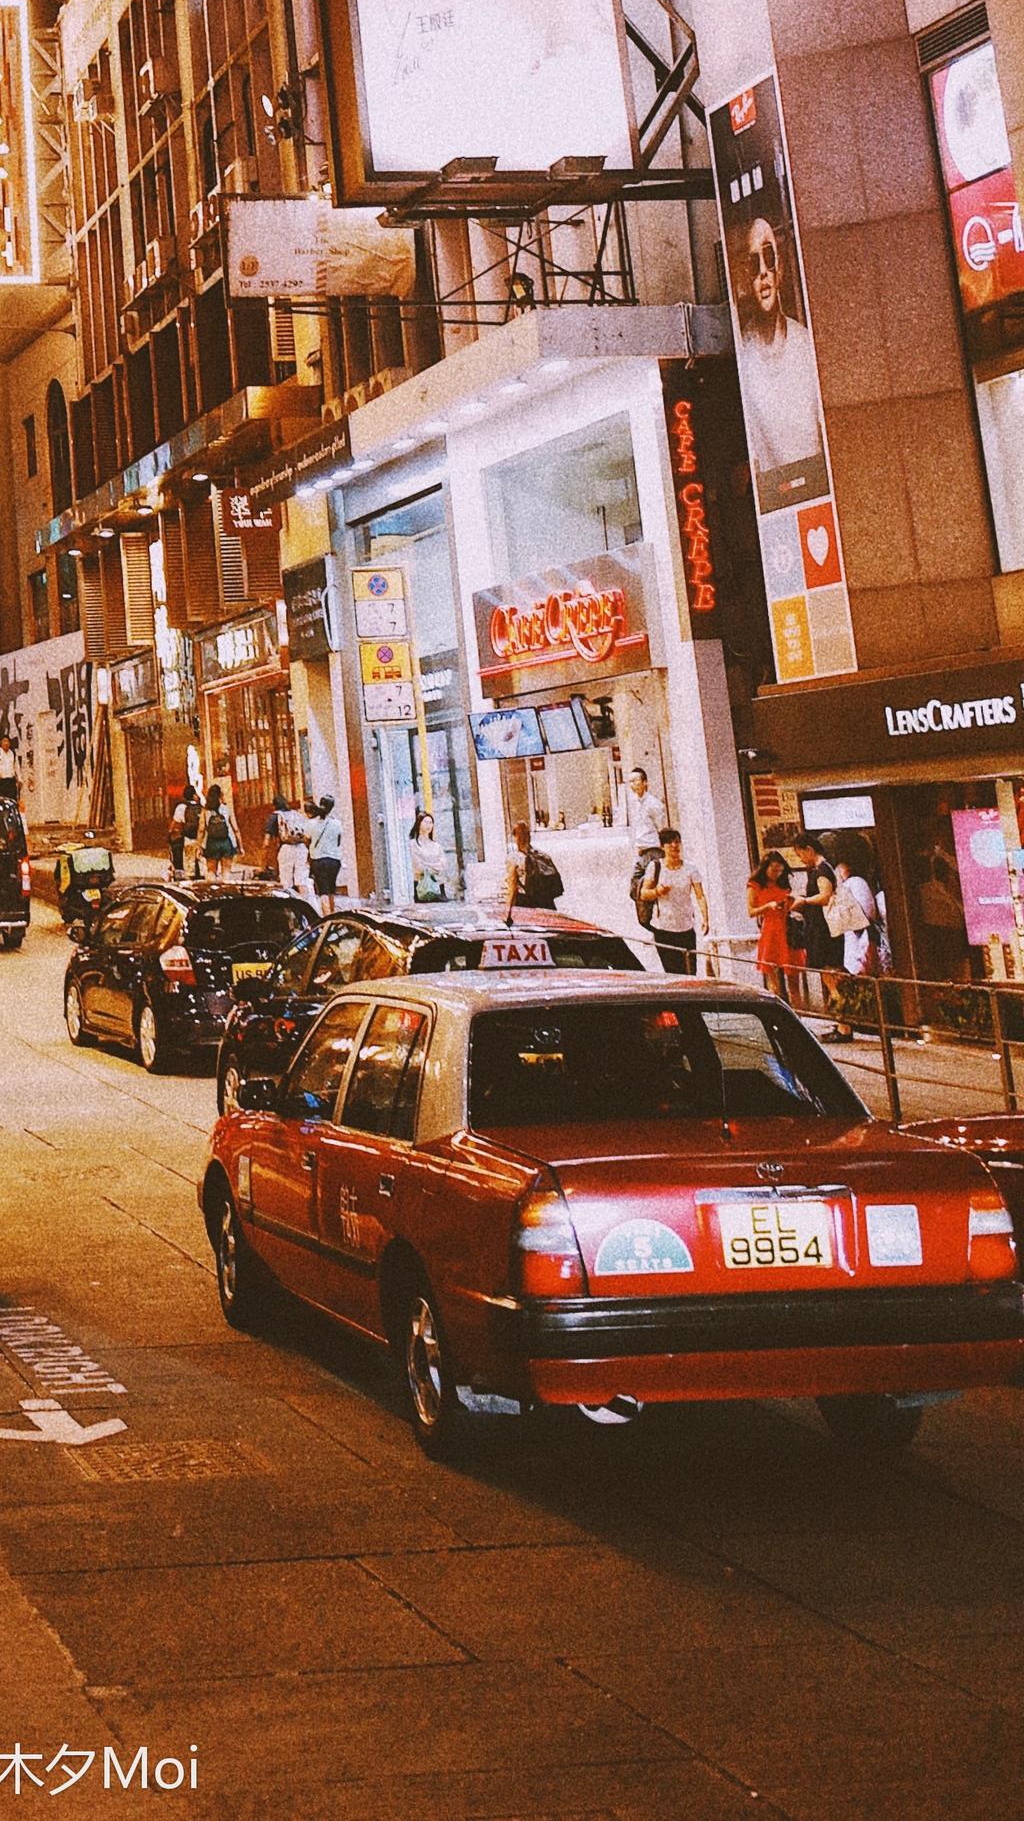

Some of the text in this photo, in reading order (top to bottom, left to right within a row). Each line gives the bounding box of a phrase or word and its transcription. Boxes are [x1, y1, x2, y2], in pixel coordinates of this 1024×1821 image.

[395, 685, 403, 696] 7
[398, 704, 412, 717] 12
[492, 943, 547, 962] TAXI
[751, 1205, 796, 1235] EL
[730, 1235, 825, 1266] 9954
